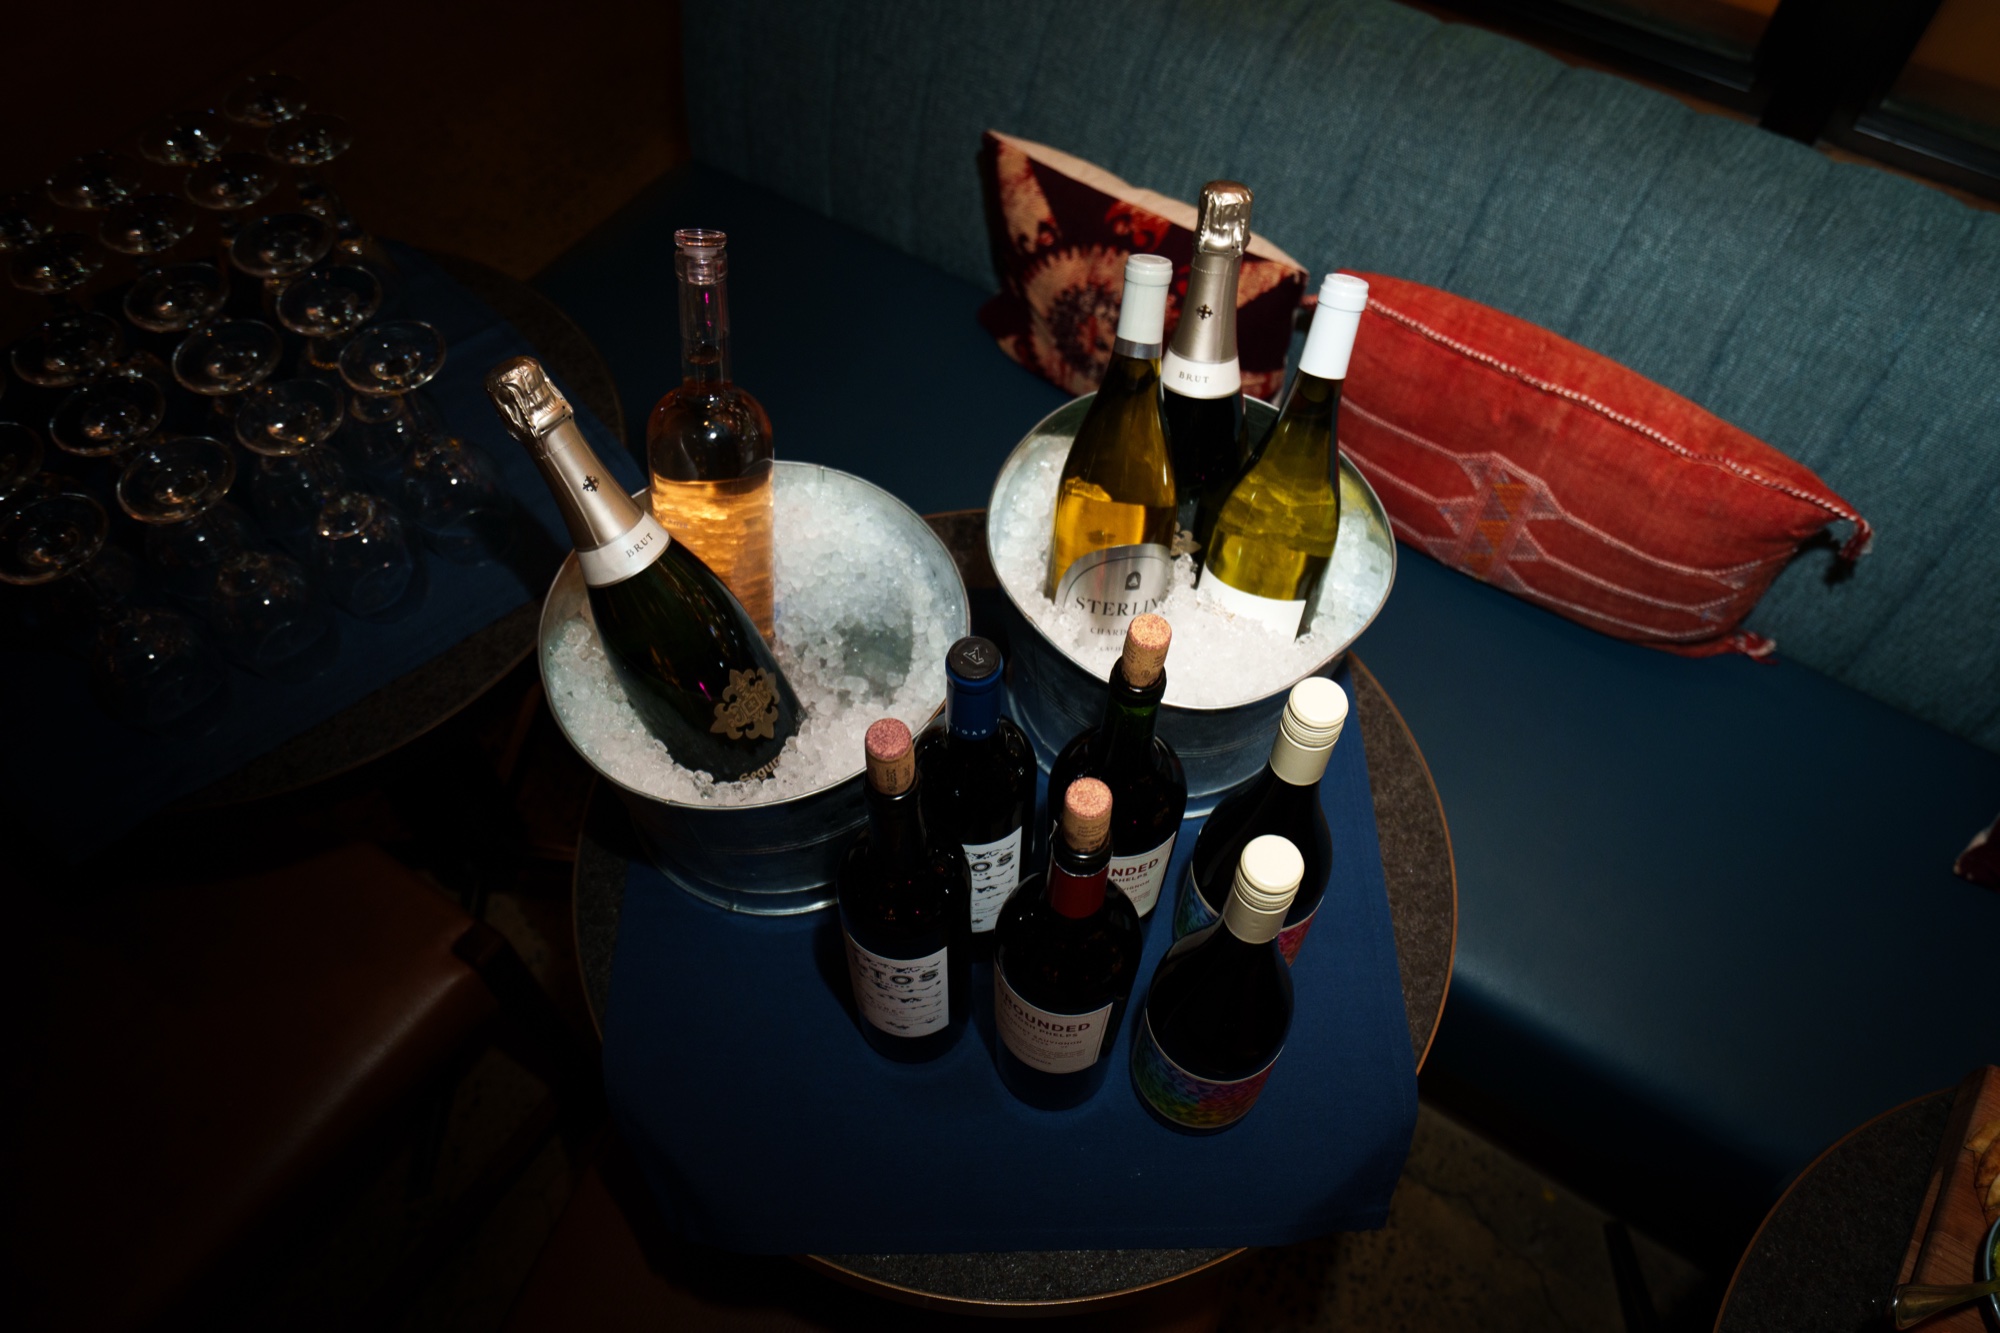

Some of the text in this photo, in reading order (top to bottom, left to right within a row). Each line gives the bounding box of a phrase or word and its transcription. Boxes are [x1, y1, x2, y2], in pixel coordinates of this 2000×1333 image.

[1179, 371, 1209, 383] BRUT
[625, 532, 654, 559] BRUT
[1090, 627, 1127, 636] CHARD
[739, 755, 781, 782] Segur
[1111, 858, 1159, 876] NDED
[1112, 873, 1148, 882] PHELPS
[1039, 1029, 1078, 1038] PHELPS
